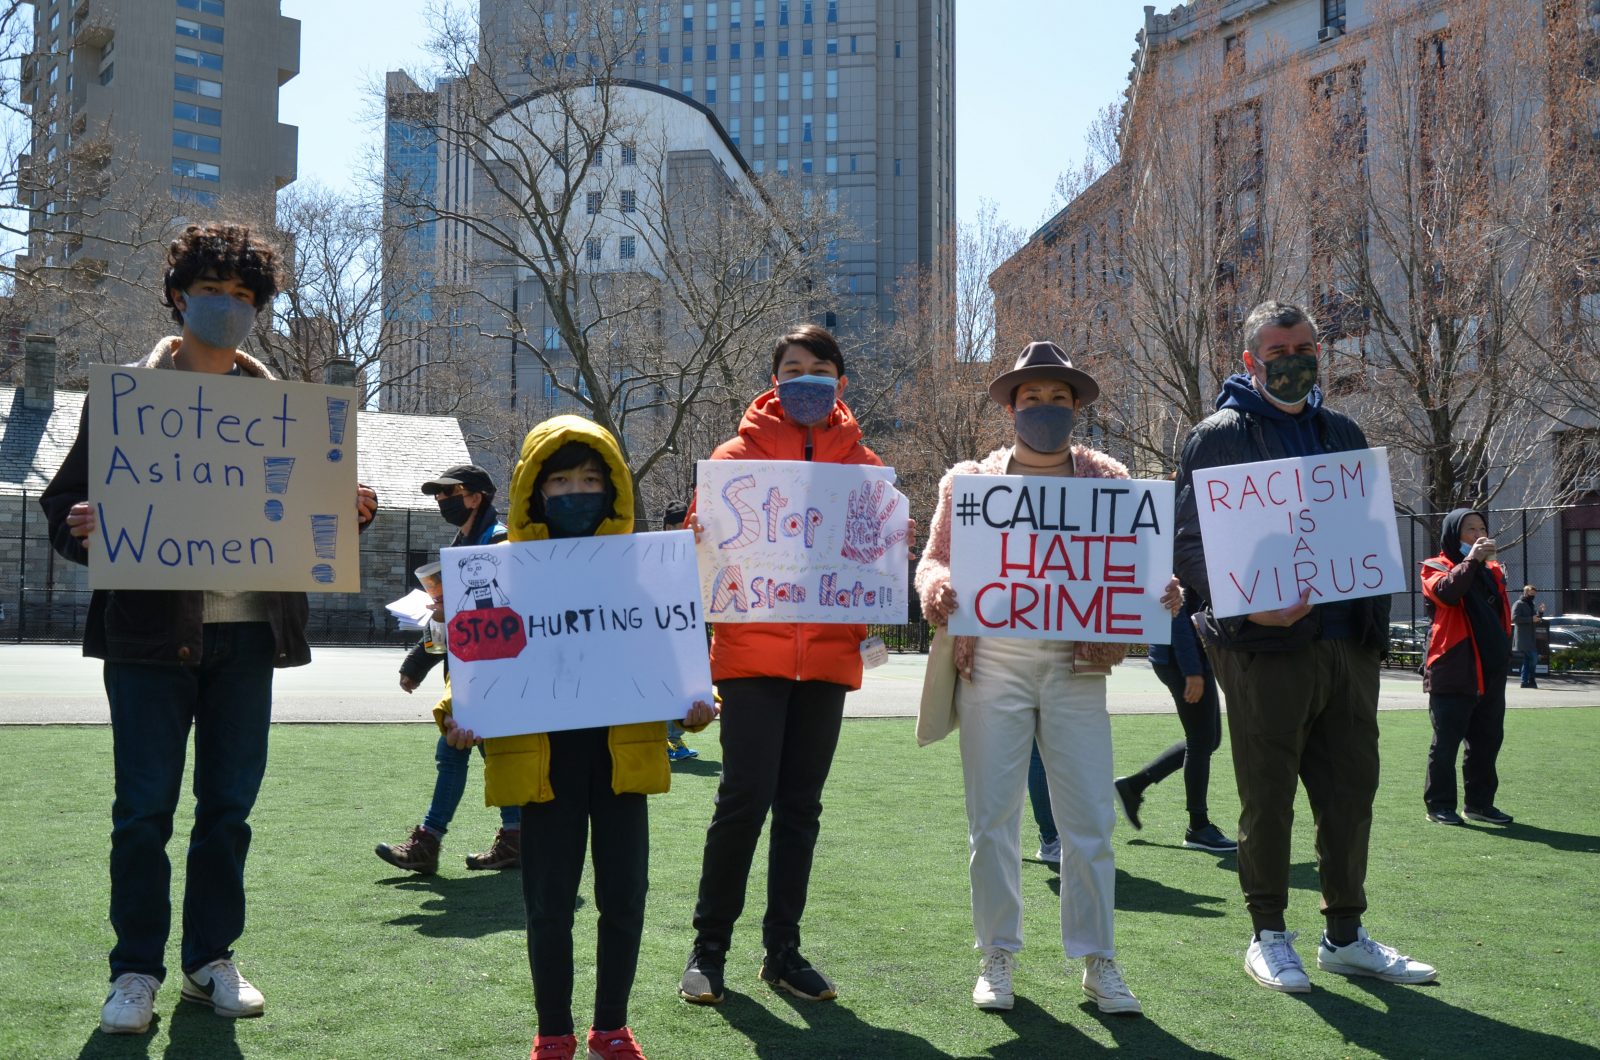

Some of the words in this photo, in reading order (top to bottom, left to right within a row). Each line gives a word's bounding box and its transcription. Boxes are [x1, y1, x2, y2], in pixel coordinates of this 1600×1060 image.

[111, 373, 297, 448] Protect
[105, 445, 244, 487] Asian
[1207, 460, 1365, 512] RACISM
[98, 502, 274, 567] Women
[717, 474, 824, 550] Stop
[1288, 509, 1316, 534] IS
[998, 532, 1138, 584] HATE
[1293, 537, 1315, 557] A
[709, 565, 806, 613] Asian
[1229, 554, 1384, 605] VIRUS
[455, 615, 519, 646] STOP
[654, 601, 697, 631] US!
[974, 582, 1145, 635] CRIME
